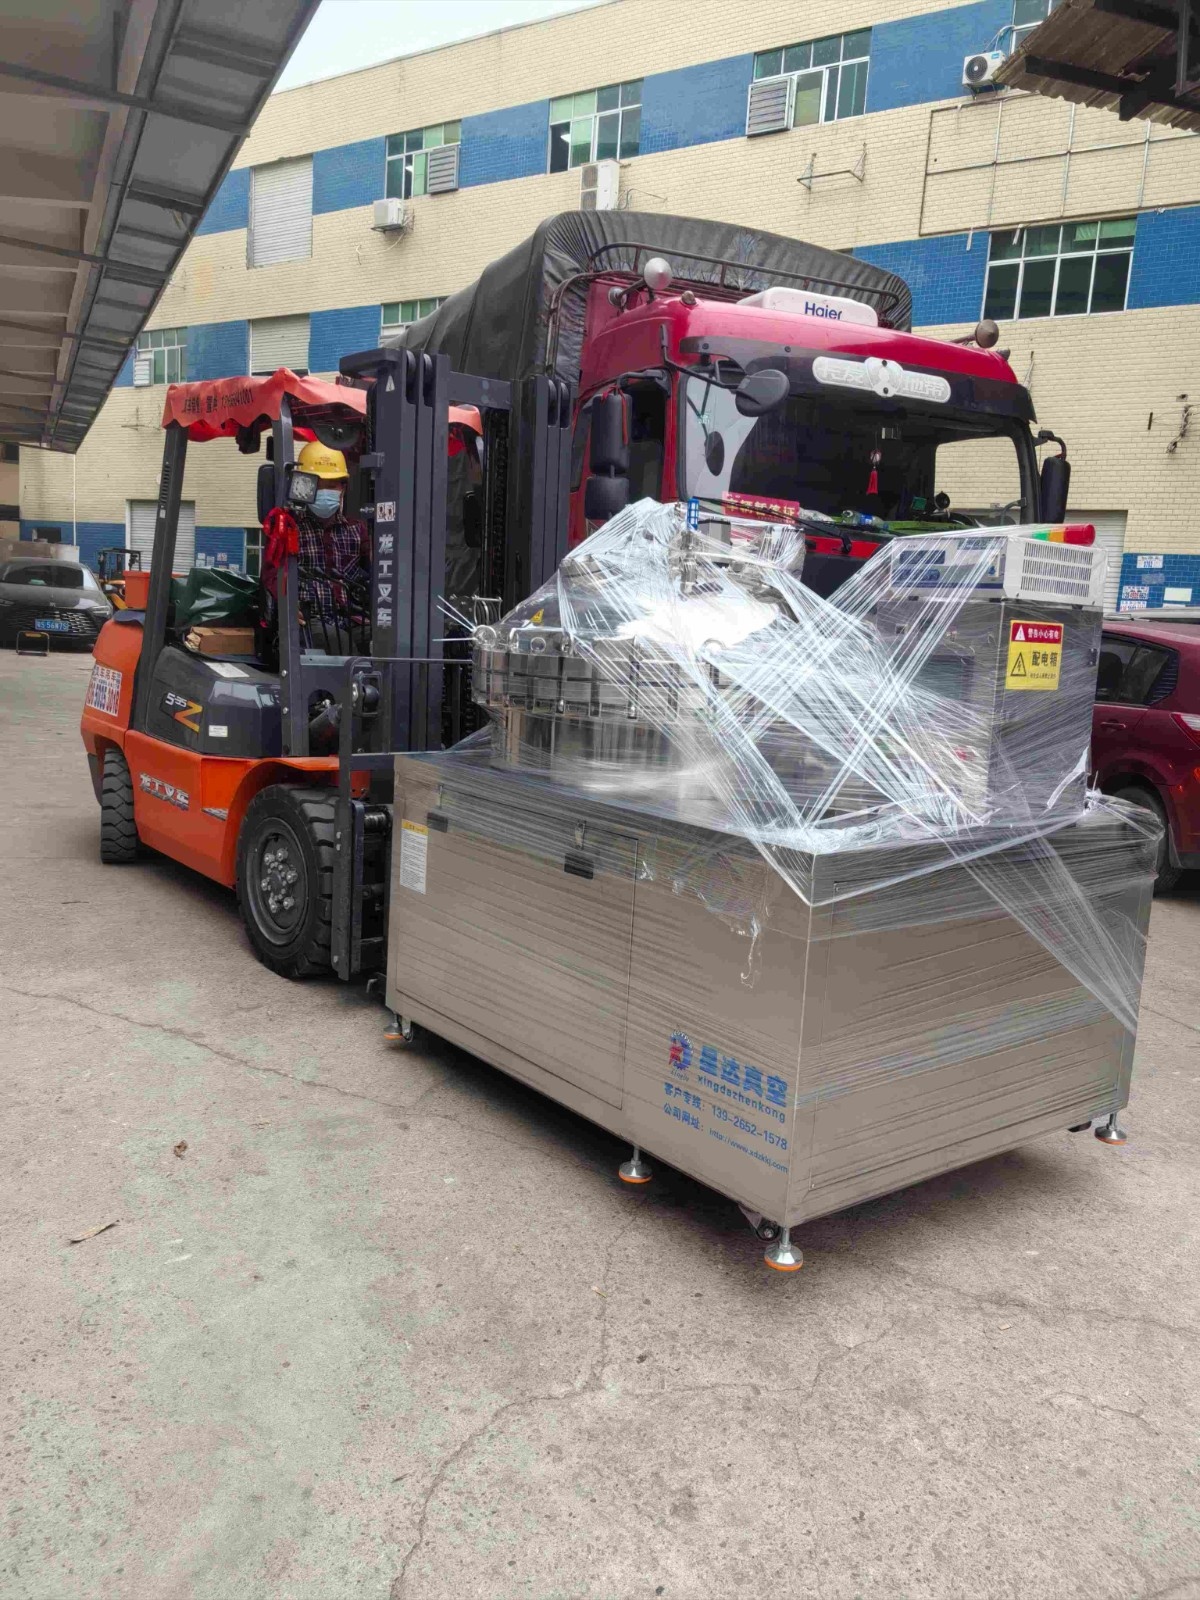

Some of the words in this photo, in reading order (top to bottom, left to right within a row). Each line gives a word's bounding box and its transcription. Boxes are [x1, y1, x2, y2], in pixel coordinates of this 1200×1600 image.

[804, 302, 843, 321] Haier
[377, 534, 394, 629] 龙工叉车
[1031, 650, 1059, 667] 配电箱
[140, 772, 189, 808] 龙工叉车
[697, 1075, 786, 1124] xingdazhenkong
[699, 1044, 788, 1108] 星达真空
[712, 1104, 789, 1151] 139-2652-1578
